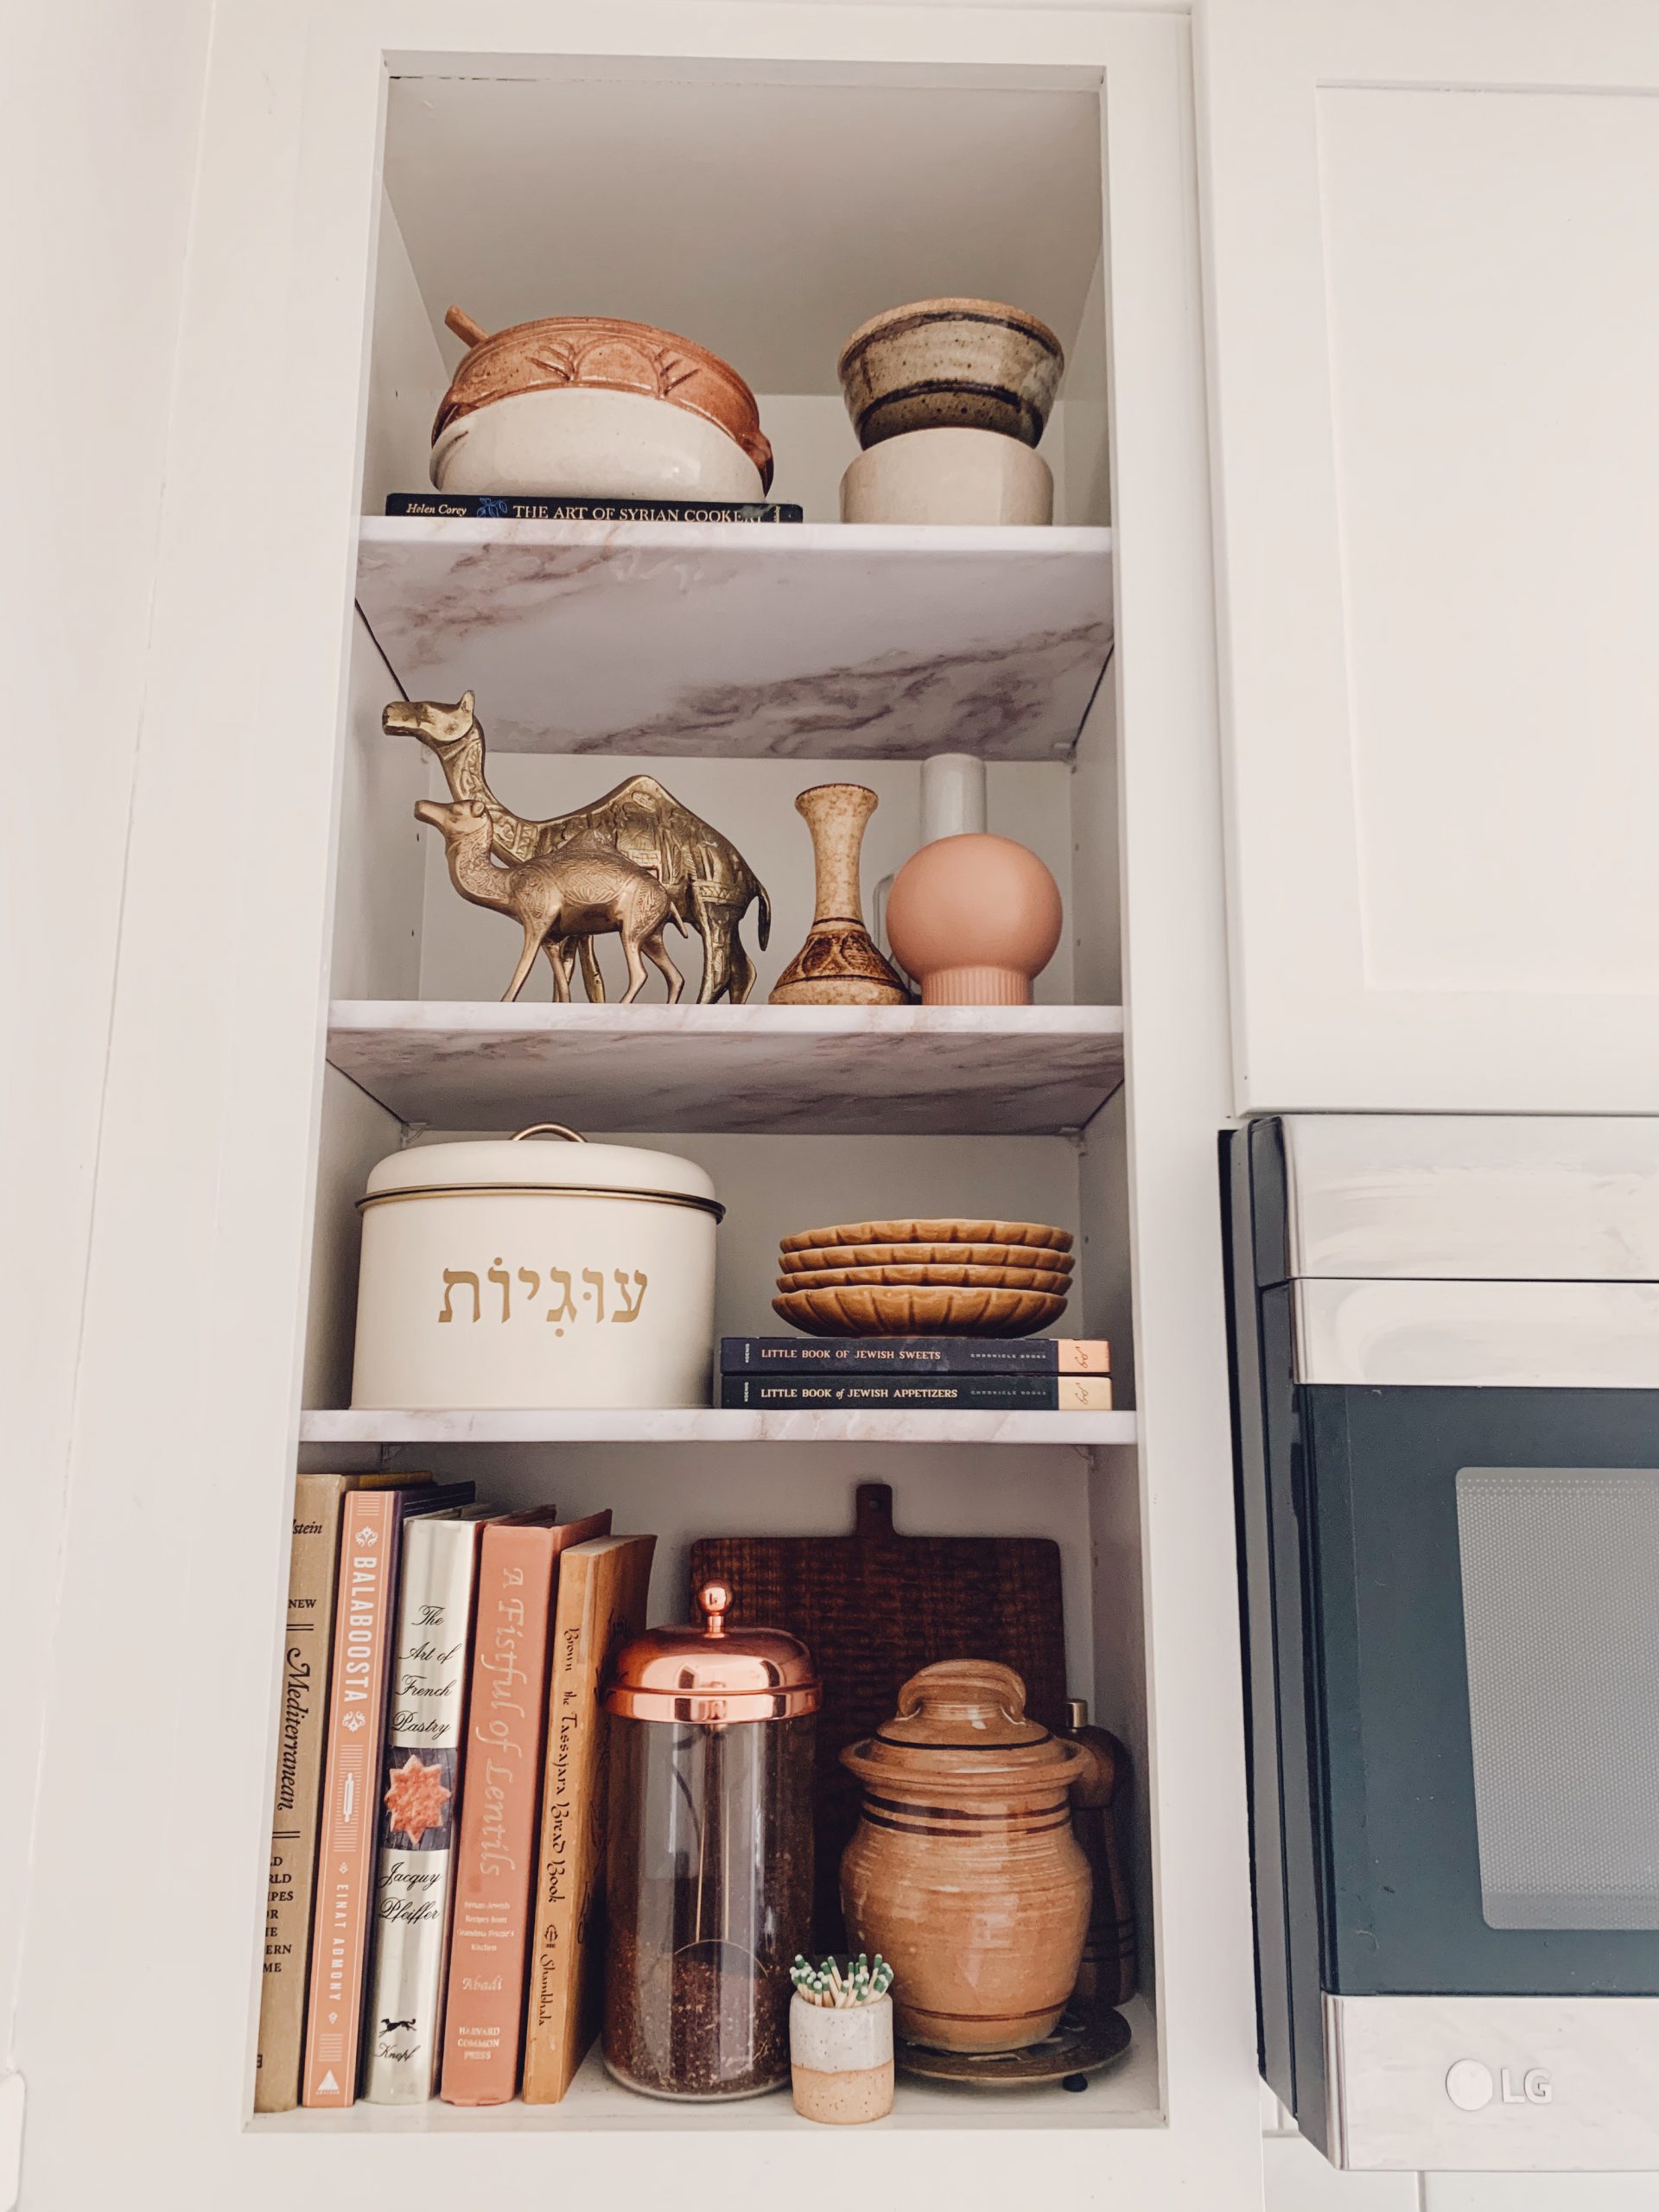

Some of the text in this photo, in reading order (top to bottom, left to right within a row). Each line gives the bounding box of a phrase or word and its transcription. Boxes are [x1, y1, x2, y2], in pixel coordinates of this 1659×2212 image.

[406, 503, 467, 517] Helen Corey
[513, 505, 549, 518] THE
[554, 506, 588, 519] ART
[593, 508, 615, 520] OF
[620, 508, 679, 522] SYRIAN
[761, 1349, 941, 1360] LITTLE BOOK OF JEWISH SWEETS
[761, 1389, 958, 1400] LITTLE BOOK of JEWISH APPETIZERS
[288, 1599, 317, 1609] NEW
[410, 1605, 446, 1626] The
[343, 1556, 377, 1703] BALABOOSTA
[398, 1642, 462, 1664] Art of
[563, 1628, 580, 1672] Brown
[395, 1675, 457, 1697] French
[276, 1647, 311, 1811] Mediterranean
[391, 1710, 451, 1740] Pastry
[475, 1567, 527, 1876] A Fistful of Lentils
[547, 1690, 578, 1903] the Tassajara Bread Book
[377, 1861, 442, 1891] Jacquy
[378, 1897, 441, 1924] Pfeiffer
[328, 1884, 349, 2000] EINAT ADMONY
[462, 1974, 504, 1992] Abadi
[539, 1954, 556, 2026] Shambhala
[459, 2026, 500, 2036] HARVARD
[374, 2042, 421, 2063] Knopf
[457, 2038, 500, 2048] COMMON
[1500, 2067, 1553, 2105] LG
